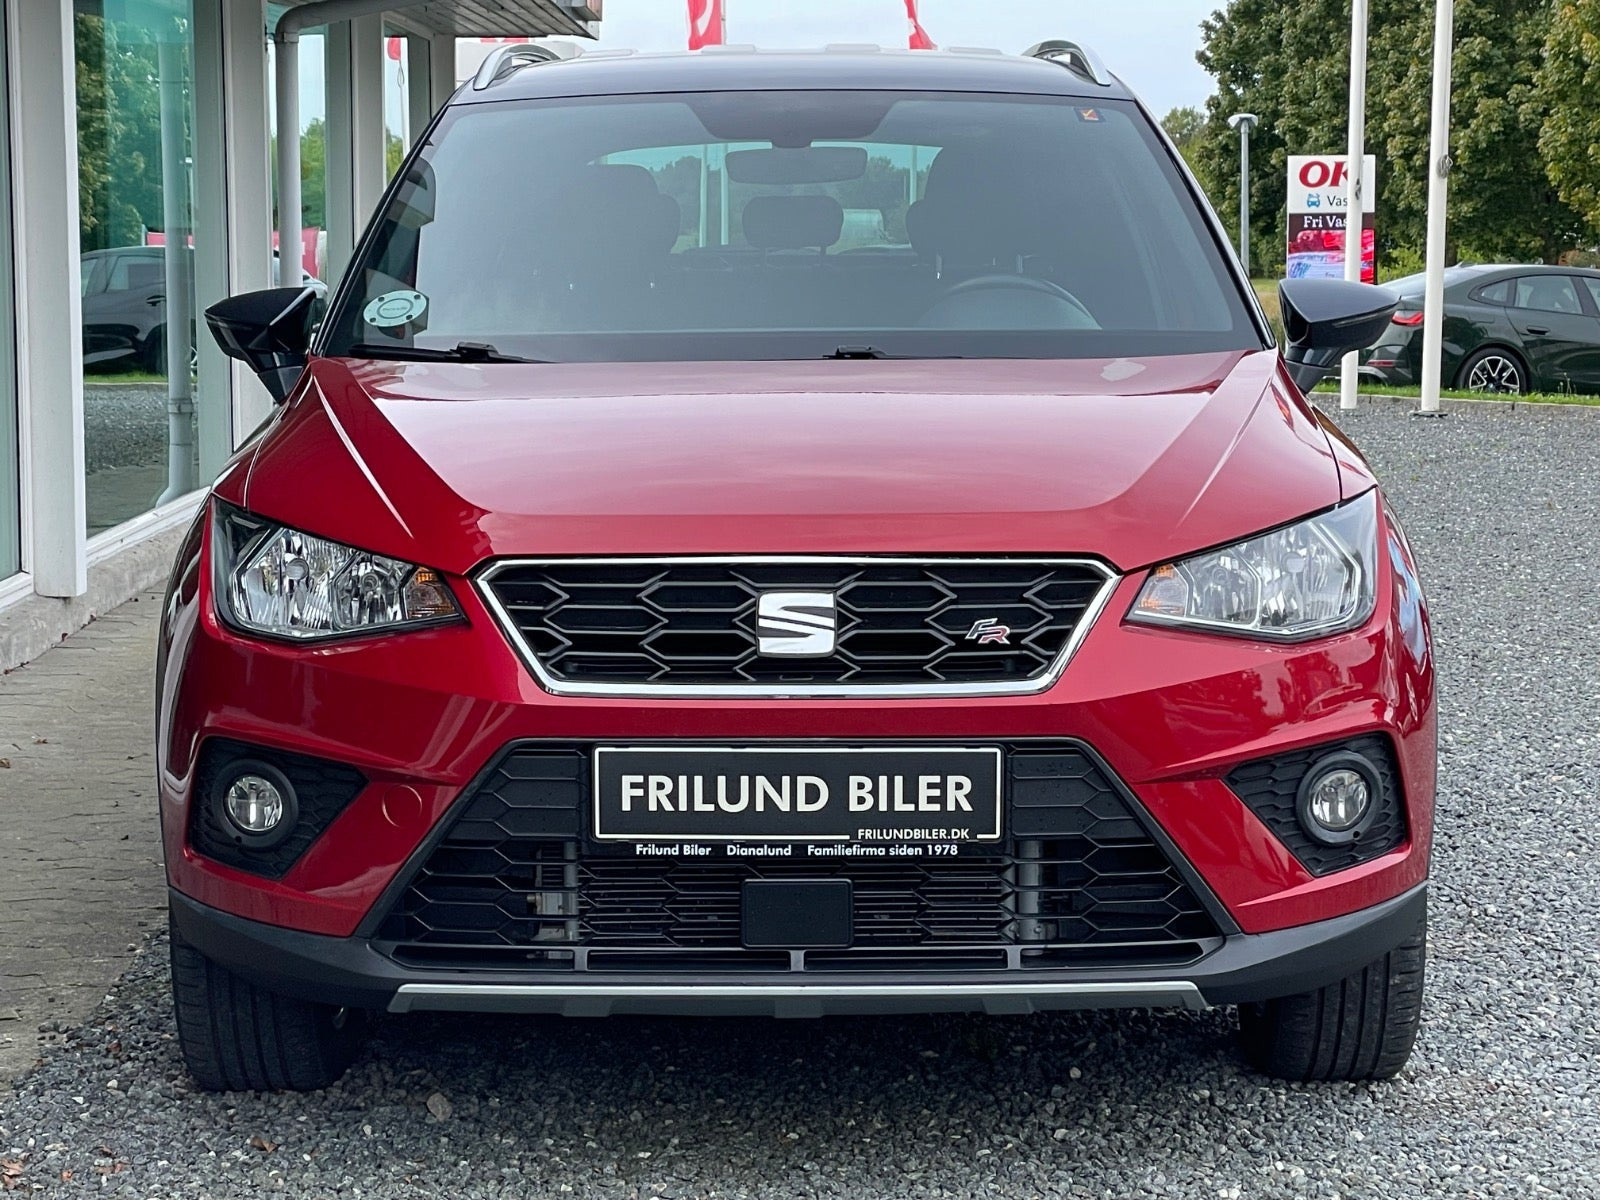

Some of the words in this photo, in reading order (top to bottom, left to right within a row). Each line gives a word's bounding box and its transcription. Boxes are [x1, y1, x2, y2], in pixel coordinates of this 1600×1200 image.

[1303, 215, 1323, 228] Fri
[965, 617, 1010, 644] FR
[621, 775, 829, 813] FRILUND
[848, 775, 973, 812] BILER
[857, 828, 970, 840] FRILUNDBILER.DK
[635, 844, 679, 856] Frilund
[683, 844, 712, 856] Biler
[726, 844, 792, 856] Dianalund
[807, 844, 886, 856] Familiefirma
[889, 844, 922, 856] siden
[927, 844, 958, 856] 1978
